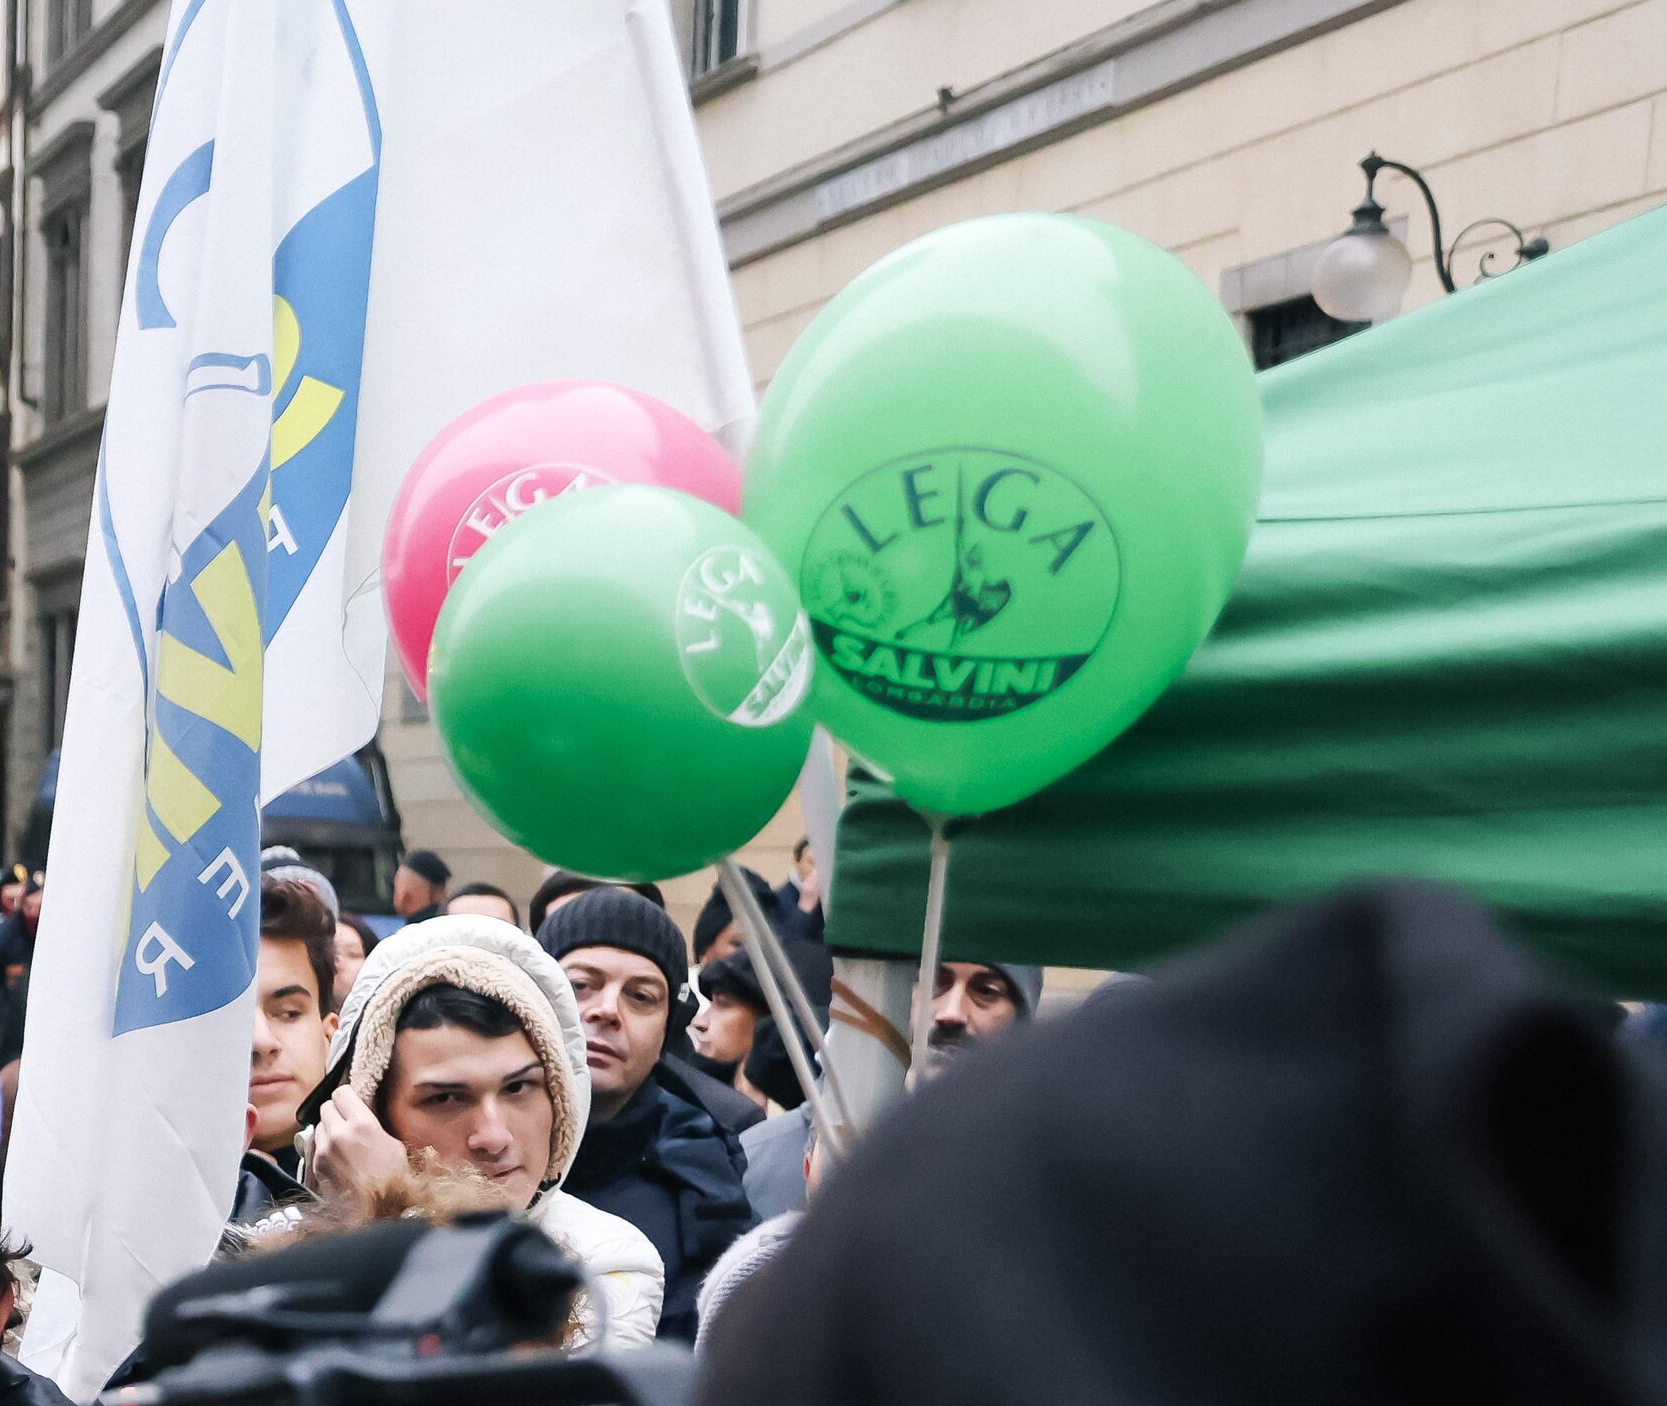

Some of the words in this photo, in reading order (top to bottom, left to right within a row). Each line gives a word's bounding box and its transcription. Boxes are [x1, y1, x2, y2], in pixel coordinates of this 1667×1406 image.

[840, 464, 1095, 574] LEGA
[683, 552, 763, 653] LEGA
[831, 634, 1059, 695] SALVINI
